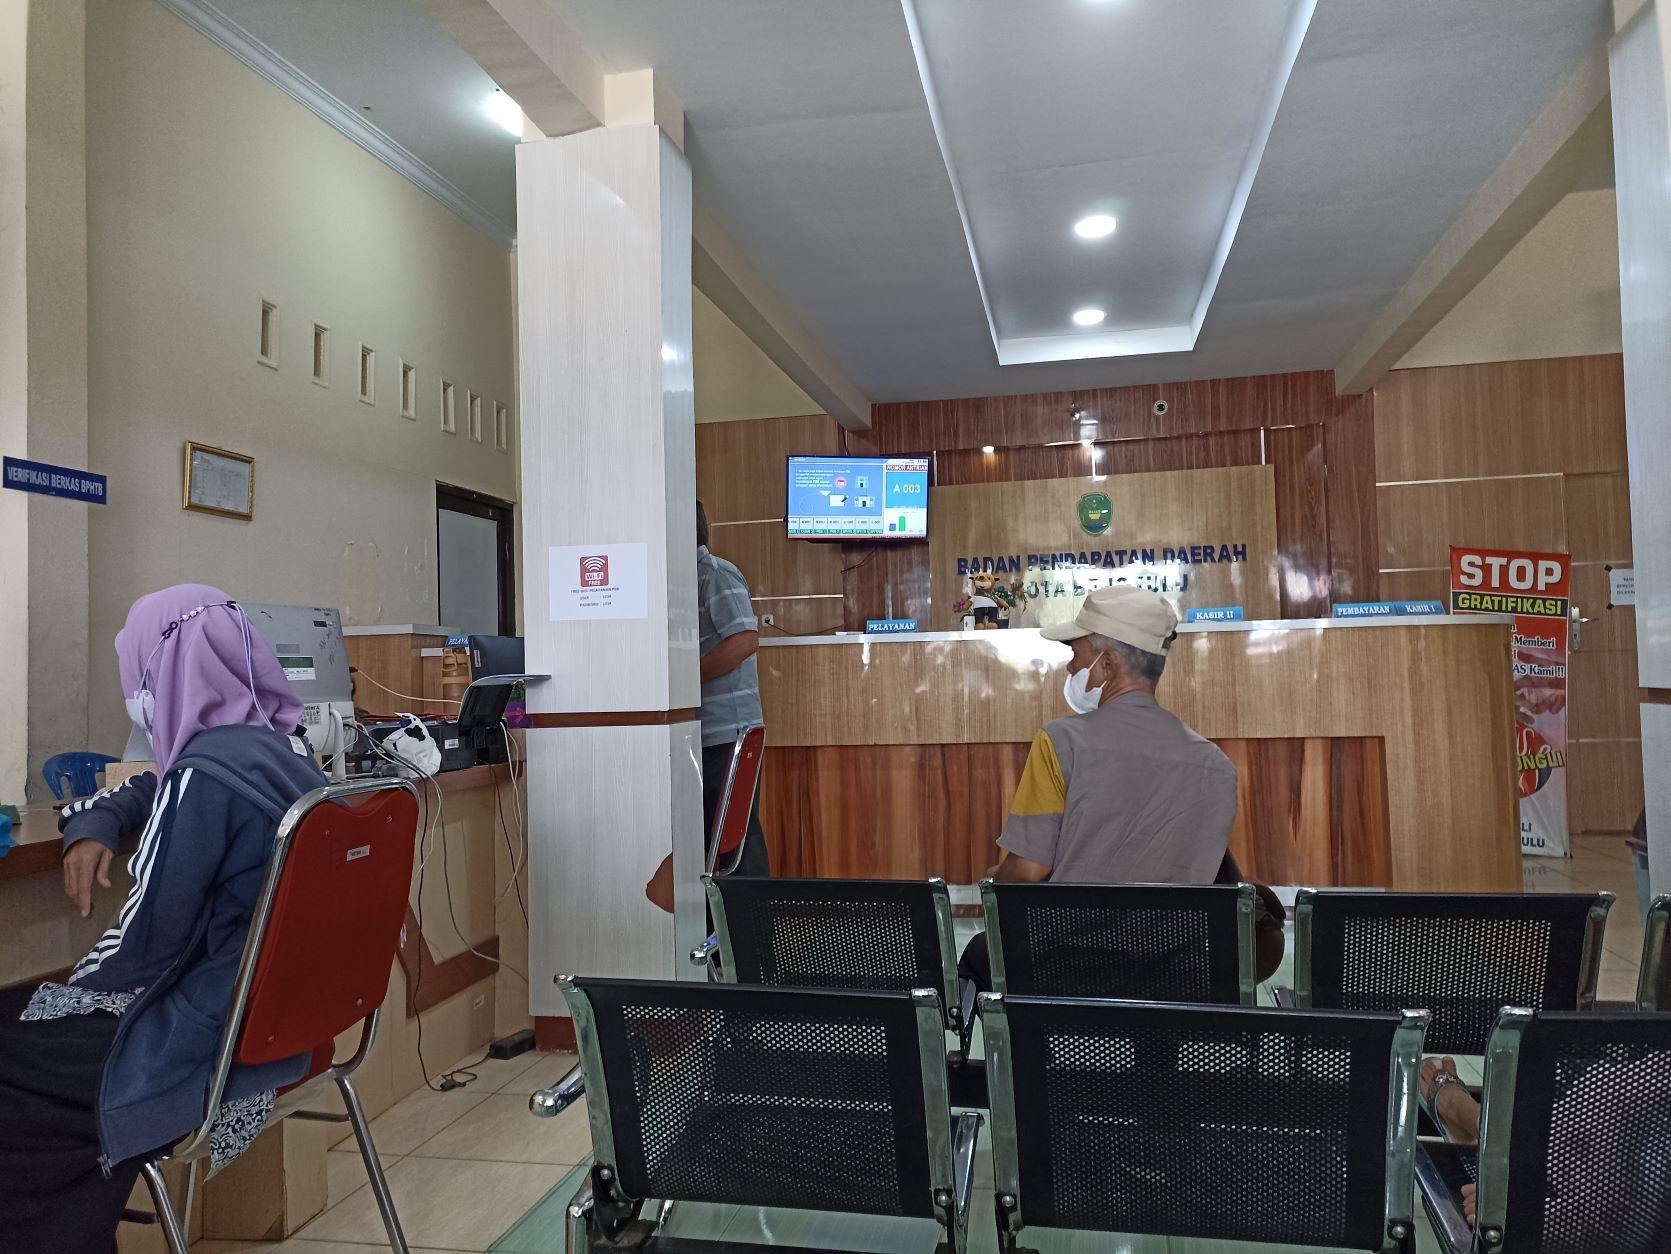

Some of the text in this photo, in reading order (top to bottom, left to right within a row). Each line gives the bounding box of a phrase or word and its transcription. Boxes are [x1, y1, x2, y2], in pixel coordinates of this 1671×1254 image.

[7, 466, 103, 495] VERIFIKASI BERKAS BPHTB
[893, 484, 921, 493] A 003
[957, 543, 1247, 575] BADAN PENDAPATAN DAERAH
[586, 572, 604, 580] Wi-Fi
[1460, 554, 1562, 591] STOP
[1338, 604, 1390, 615] PEMBAYARAN
[1405, 604, 1430, 613] KASIR
[1458, 593, 1562, 615] GRATIFIKASI
[1196, 611, 1225, 620] KASIR
[868, 622, 916, 631] PELAYANAN
[1514, 634, 1555, 648] Memberi
[1529, 664, 1555, 676] Kami
